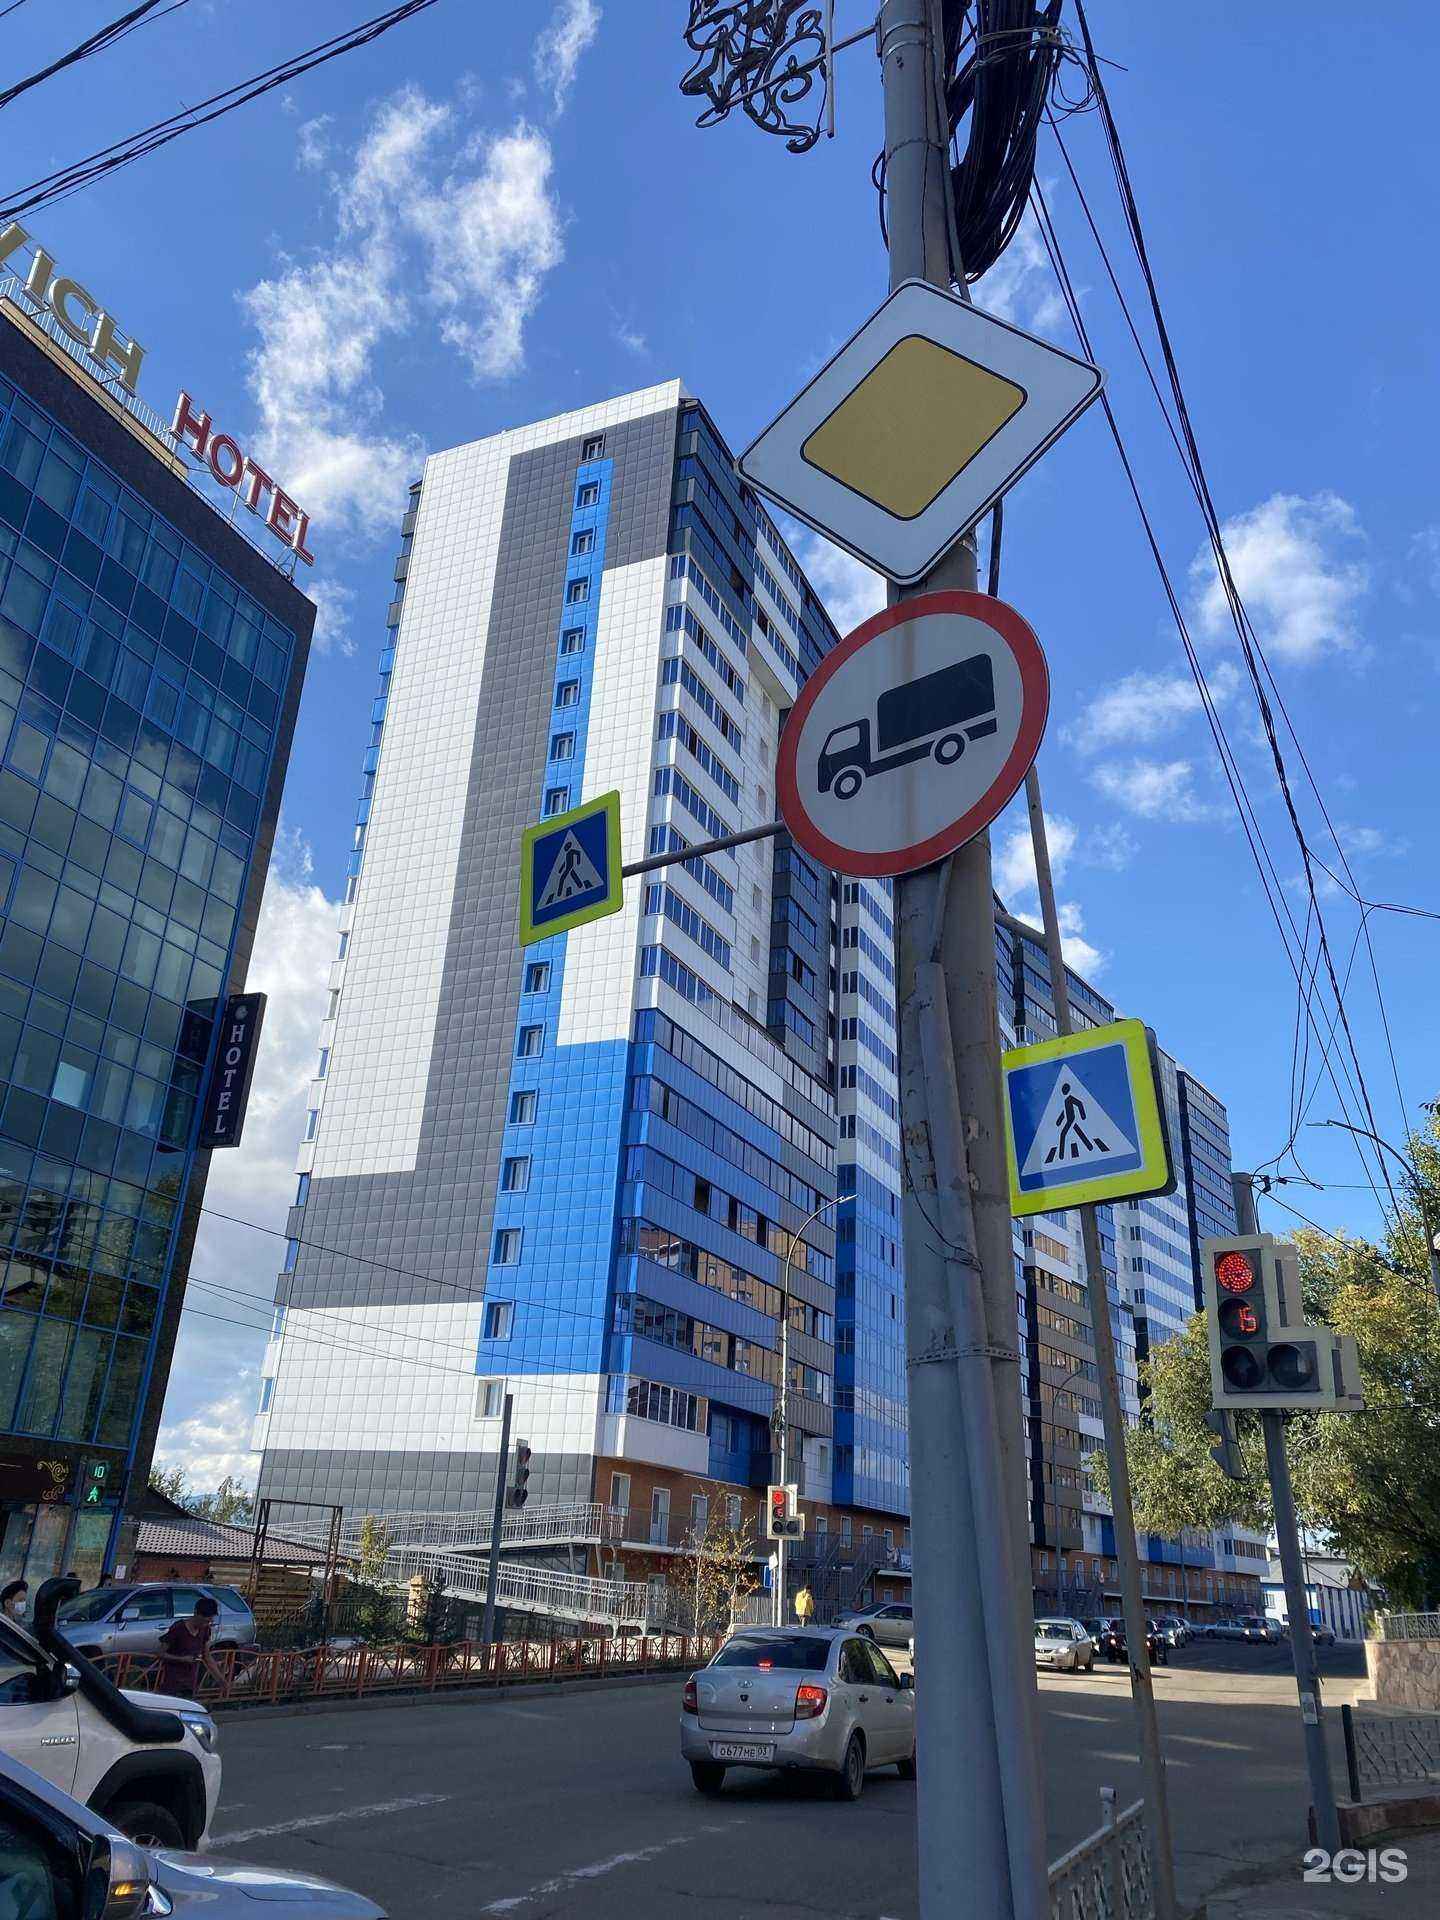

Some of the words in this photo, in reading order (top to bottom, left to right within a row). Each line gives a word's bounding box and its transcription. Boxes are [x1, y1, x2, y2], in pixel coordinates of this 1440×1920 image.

[170, 389, 314, 568] HOTEL
[214, 1023, 246, 1135] HOTEL
[1239, 1306, 1257, 1332] 6
[93, 1466, 105, 1478] 10
